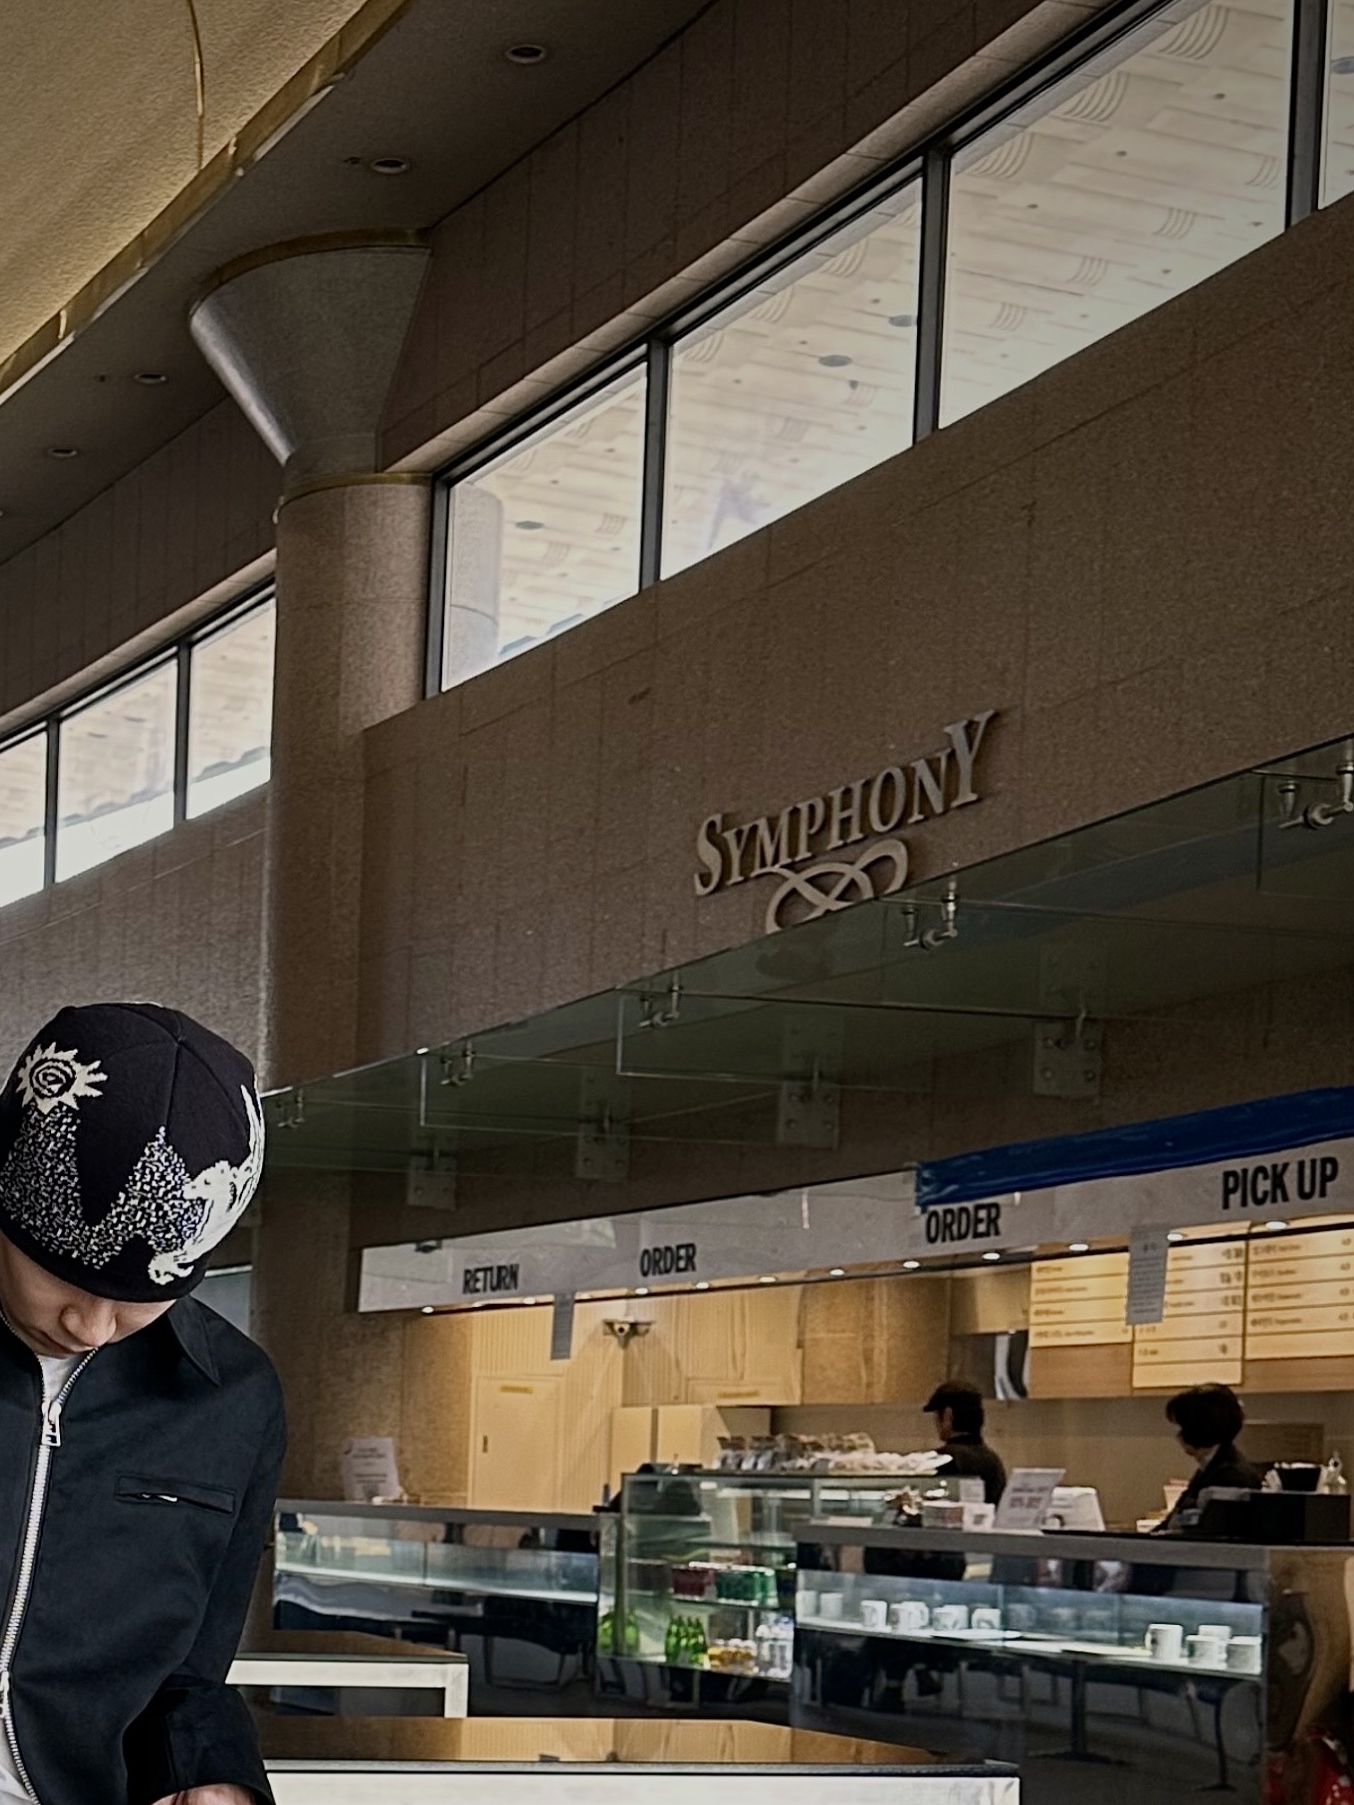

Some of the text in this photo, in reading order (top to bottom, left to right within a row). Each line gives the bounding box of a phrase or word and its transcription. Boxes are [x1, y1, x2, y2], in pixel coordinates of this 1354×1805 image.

[693, 709, 996, 896] SYMPHONY
[1222, 1156, 1338, 1210] PICK UP
[926, 1202, 1001, 1244] ORDER
[463, 1264, 519, 1294] RETURN
[640, 1243, 696, 1277] ORDER
